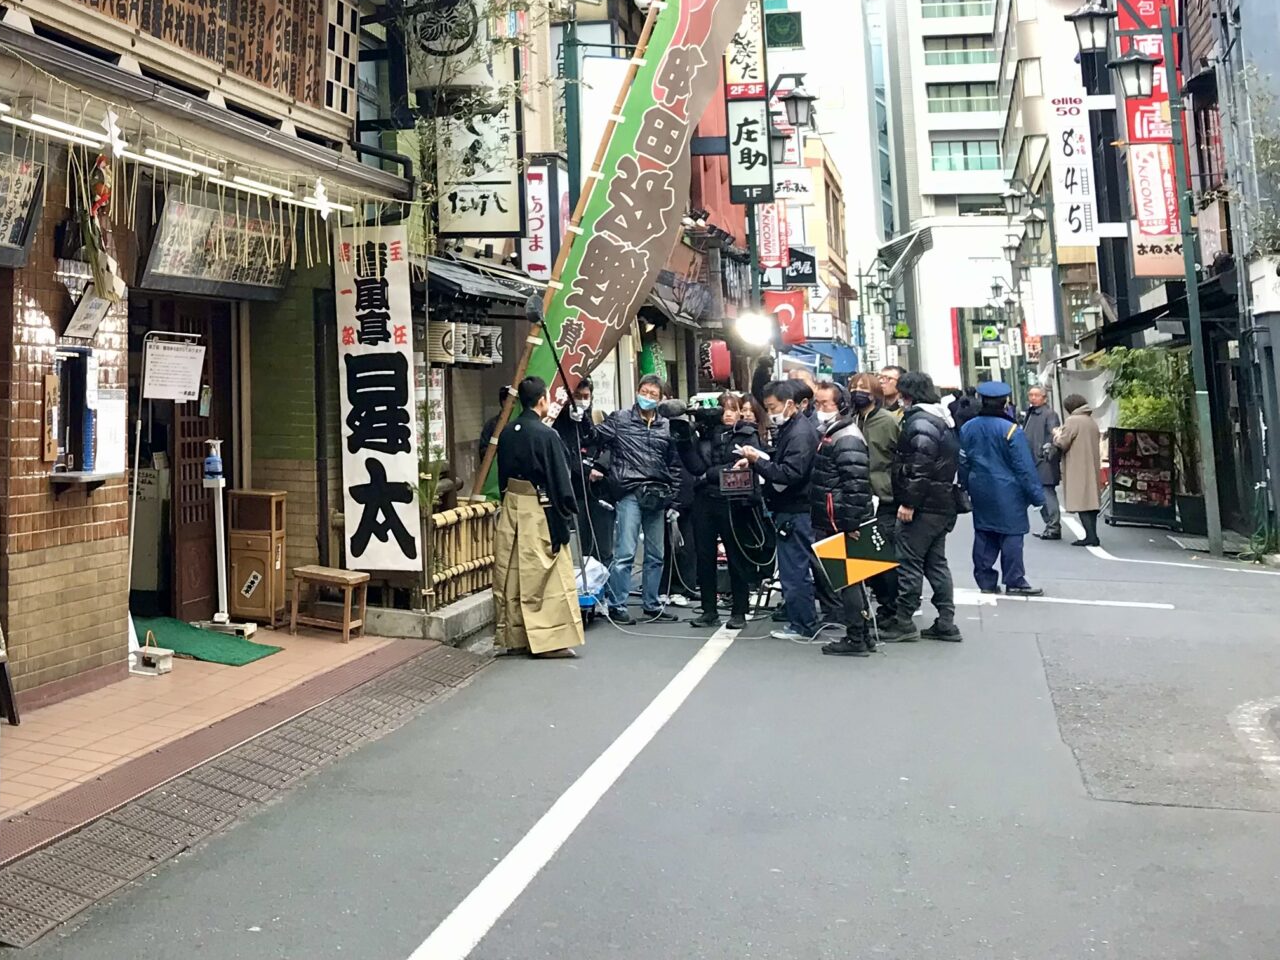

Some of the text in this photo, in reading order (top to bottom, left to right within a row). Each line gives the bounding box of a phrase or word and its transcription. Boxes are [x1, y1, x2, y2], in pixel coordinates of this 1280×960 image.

[1051, 97, 1083, 106] elite
[1055, 106, 1081, 116] 50
[732, 116, 768, 171] 庄助
[1061, 128, 1074, 157] 8
[743, 187, 762, 199] 1F
[1064, 167, 1078, 195] 4
[1068, 204, 1082, 233] 5
